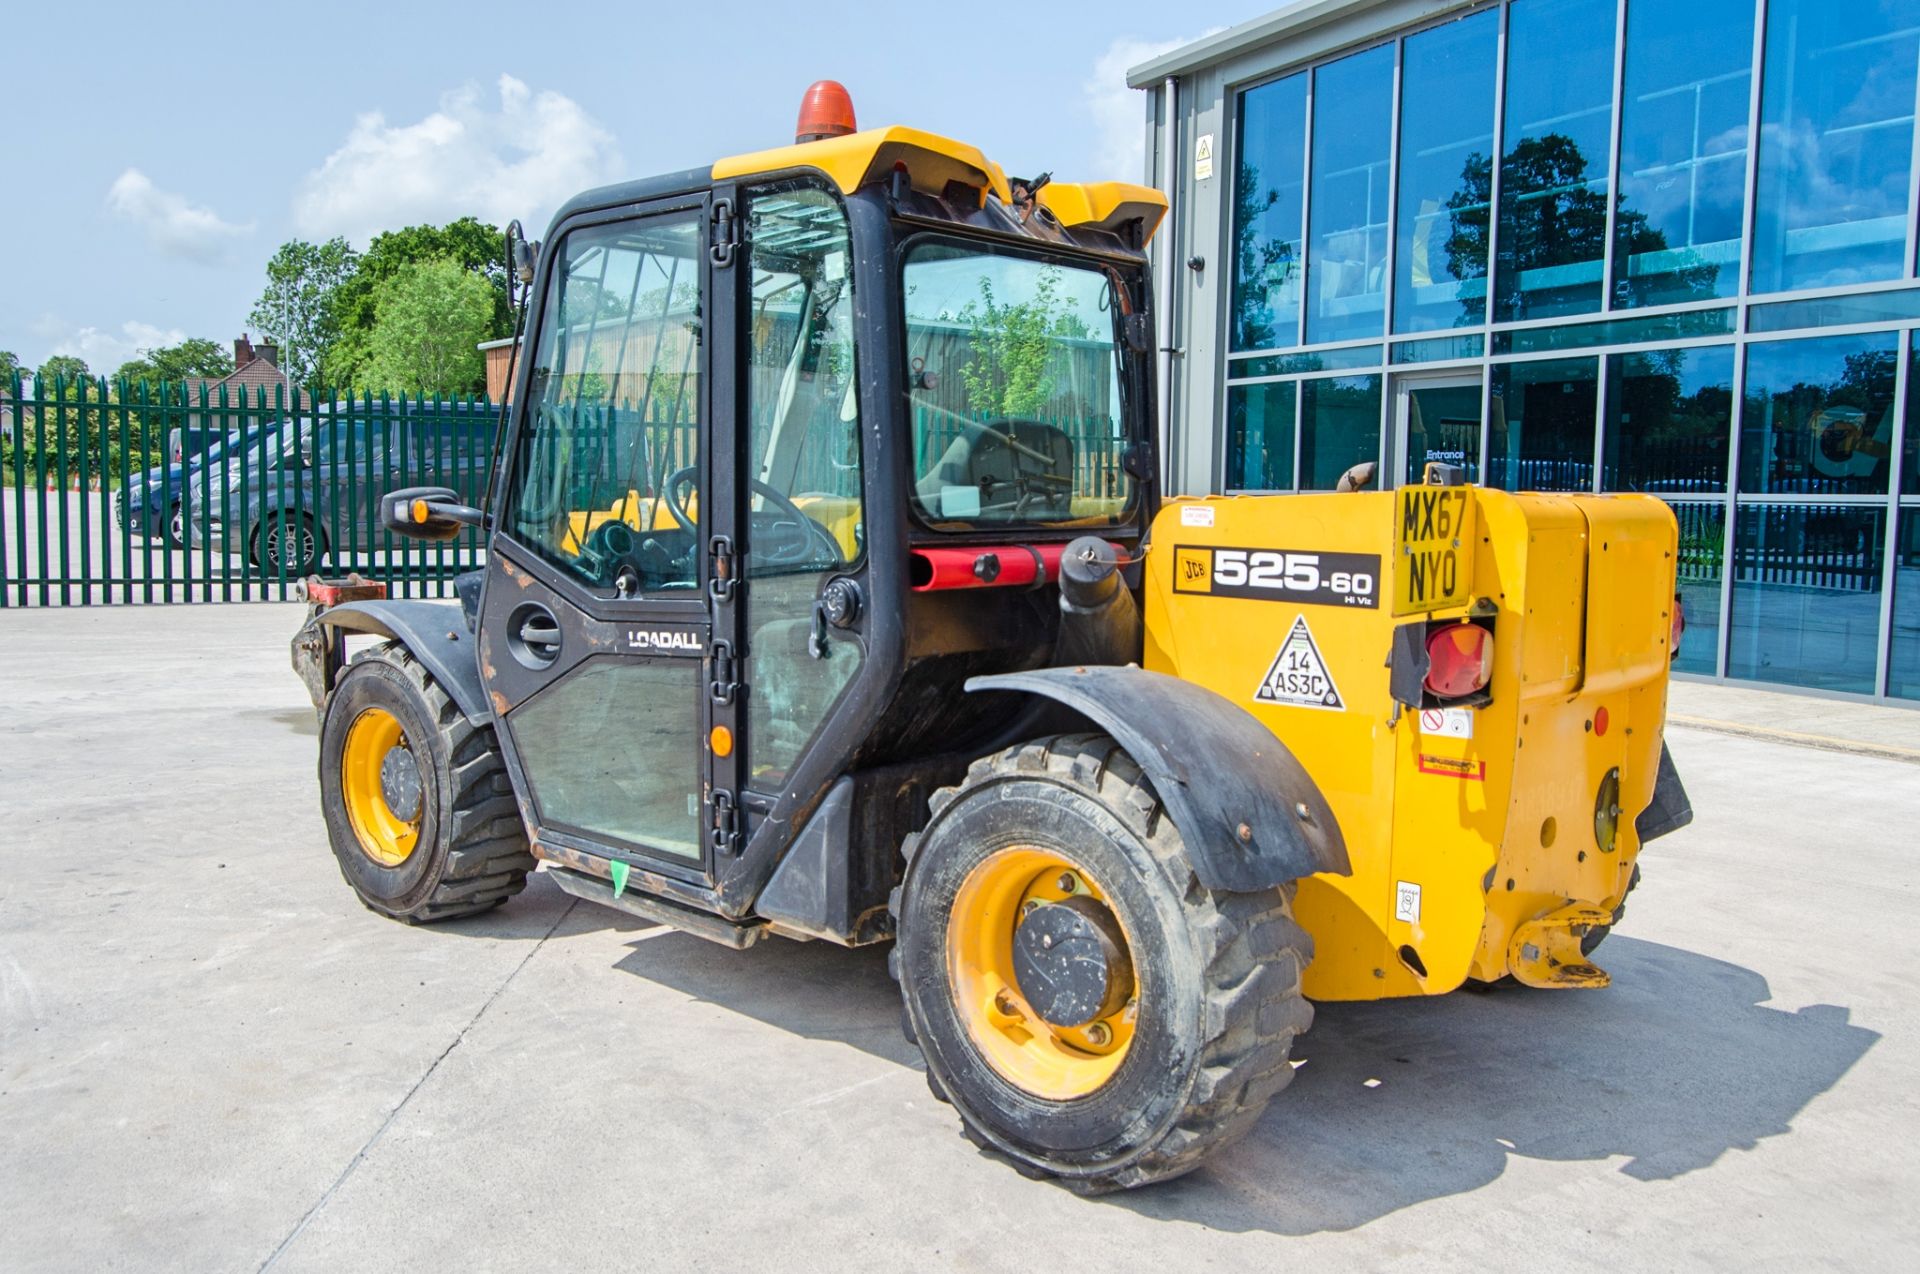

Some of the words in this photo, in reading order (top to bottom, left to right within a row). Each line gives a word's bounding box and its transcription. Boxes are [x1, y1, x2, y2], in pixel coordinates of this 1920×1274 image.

[1426, 449, 1465, 459] Entrance
[1403, 490, 1467, 542] MX67
[1185, 560, 1206, 579] JCB
[1213, 550, 1373, 595] 525-60
[1409, 549, 1456, 603] NYO
[1344, 596, 1355, 604] Hi
[1357, 596, 1372, 605] Viz
[628, 631, 702, 650] LOADALL
[1288, 651, 1310, 672] 14
[1276, 672, 1323, 696] AS3C
